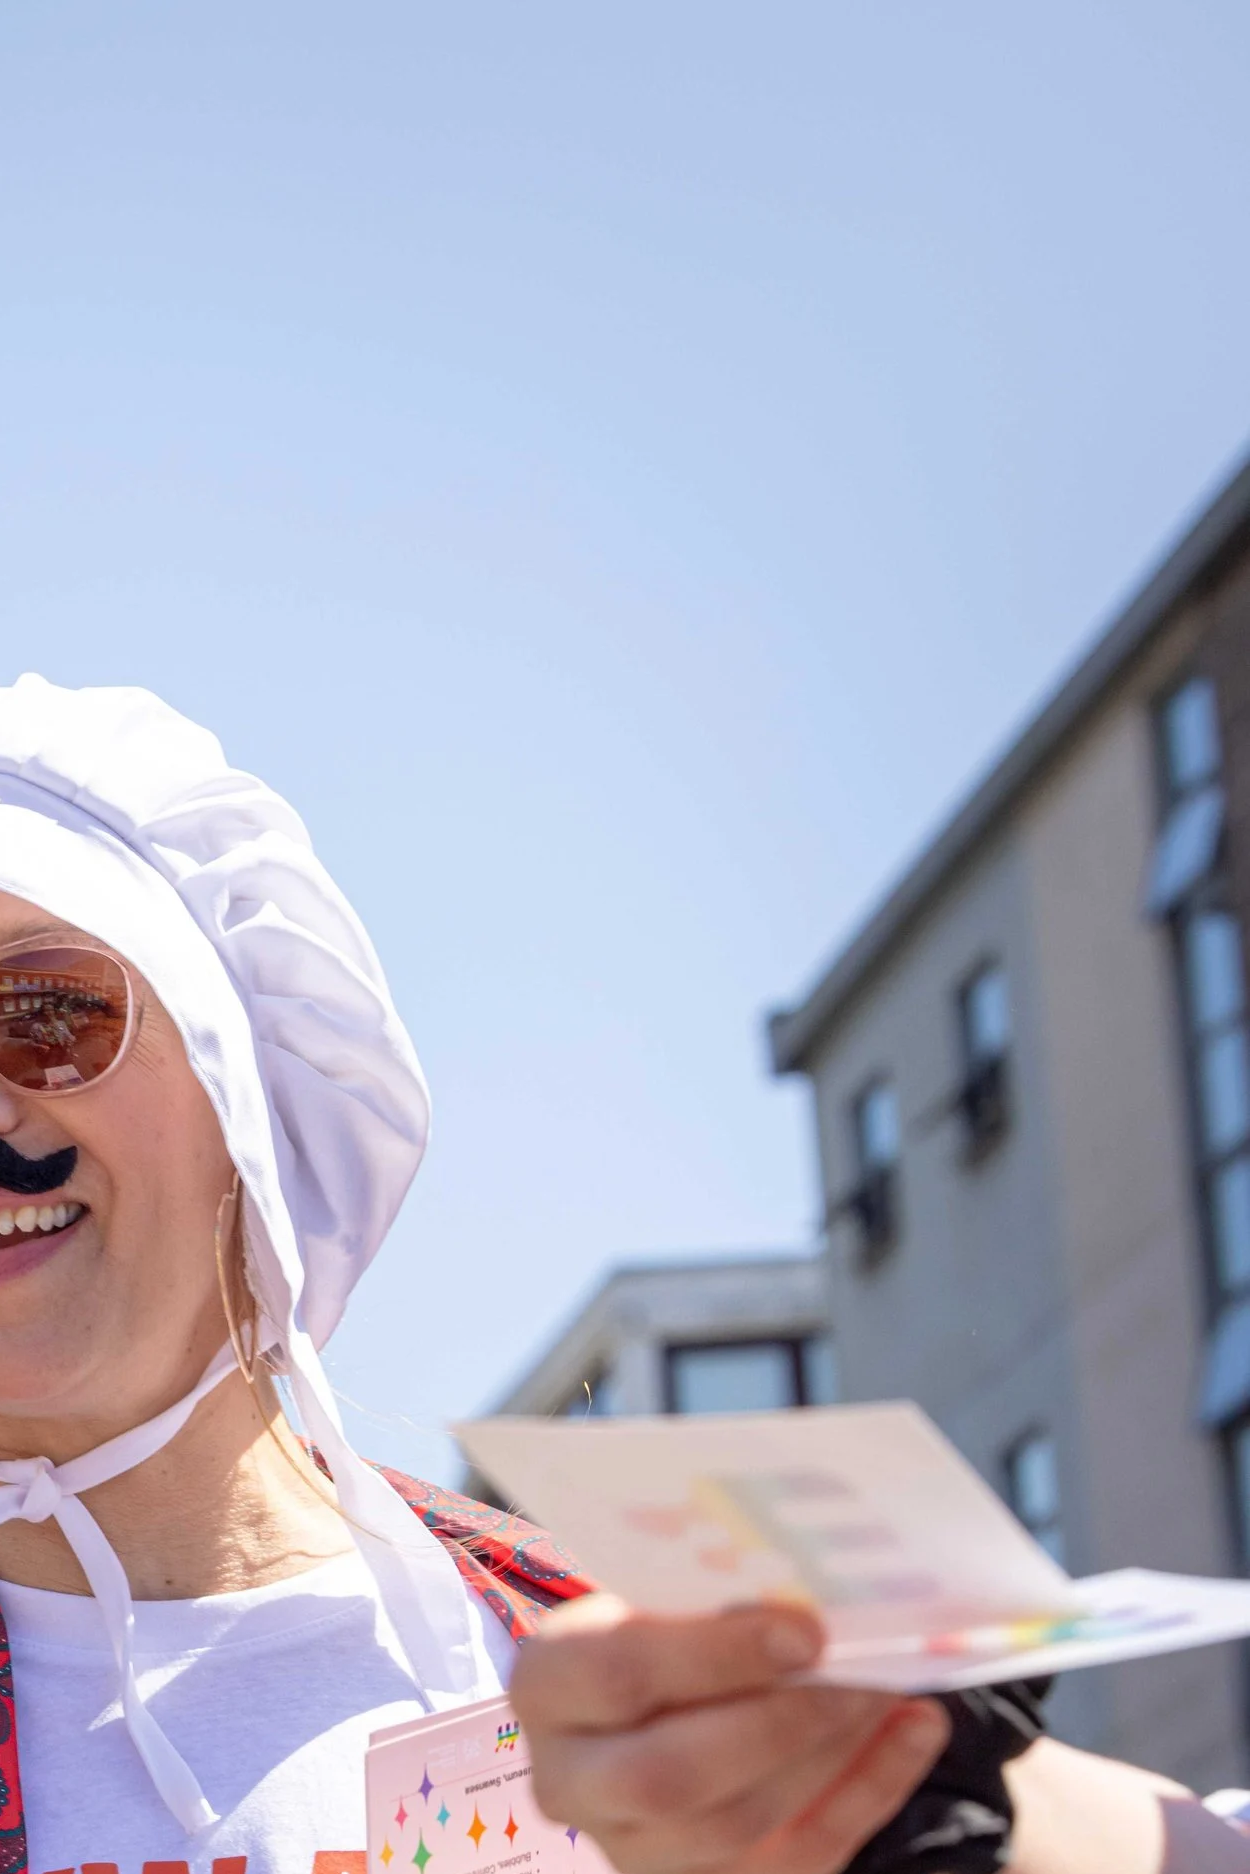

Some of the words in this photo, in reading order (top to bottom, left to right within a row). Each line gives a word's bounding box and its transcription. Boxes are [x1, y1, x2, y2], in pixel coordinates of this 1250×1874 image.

[503, 1767, 532, 1782] useum,
[465, 1777, 501, 1795] Swansea
[498, 1852, 531, 1869] Bubbles,
